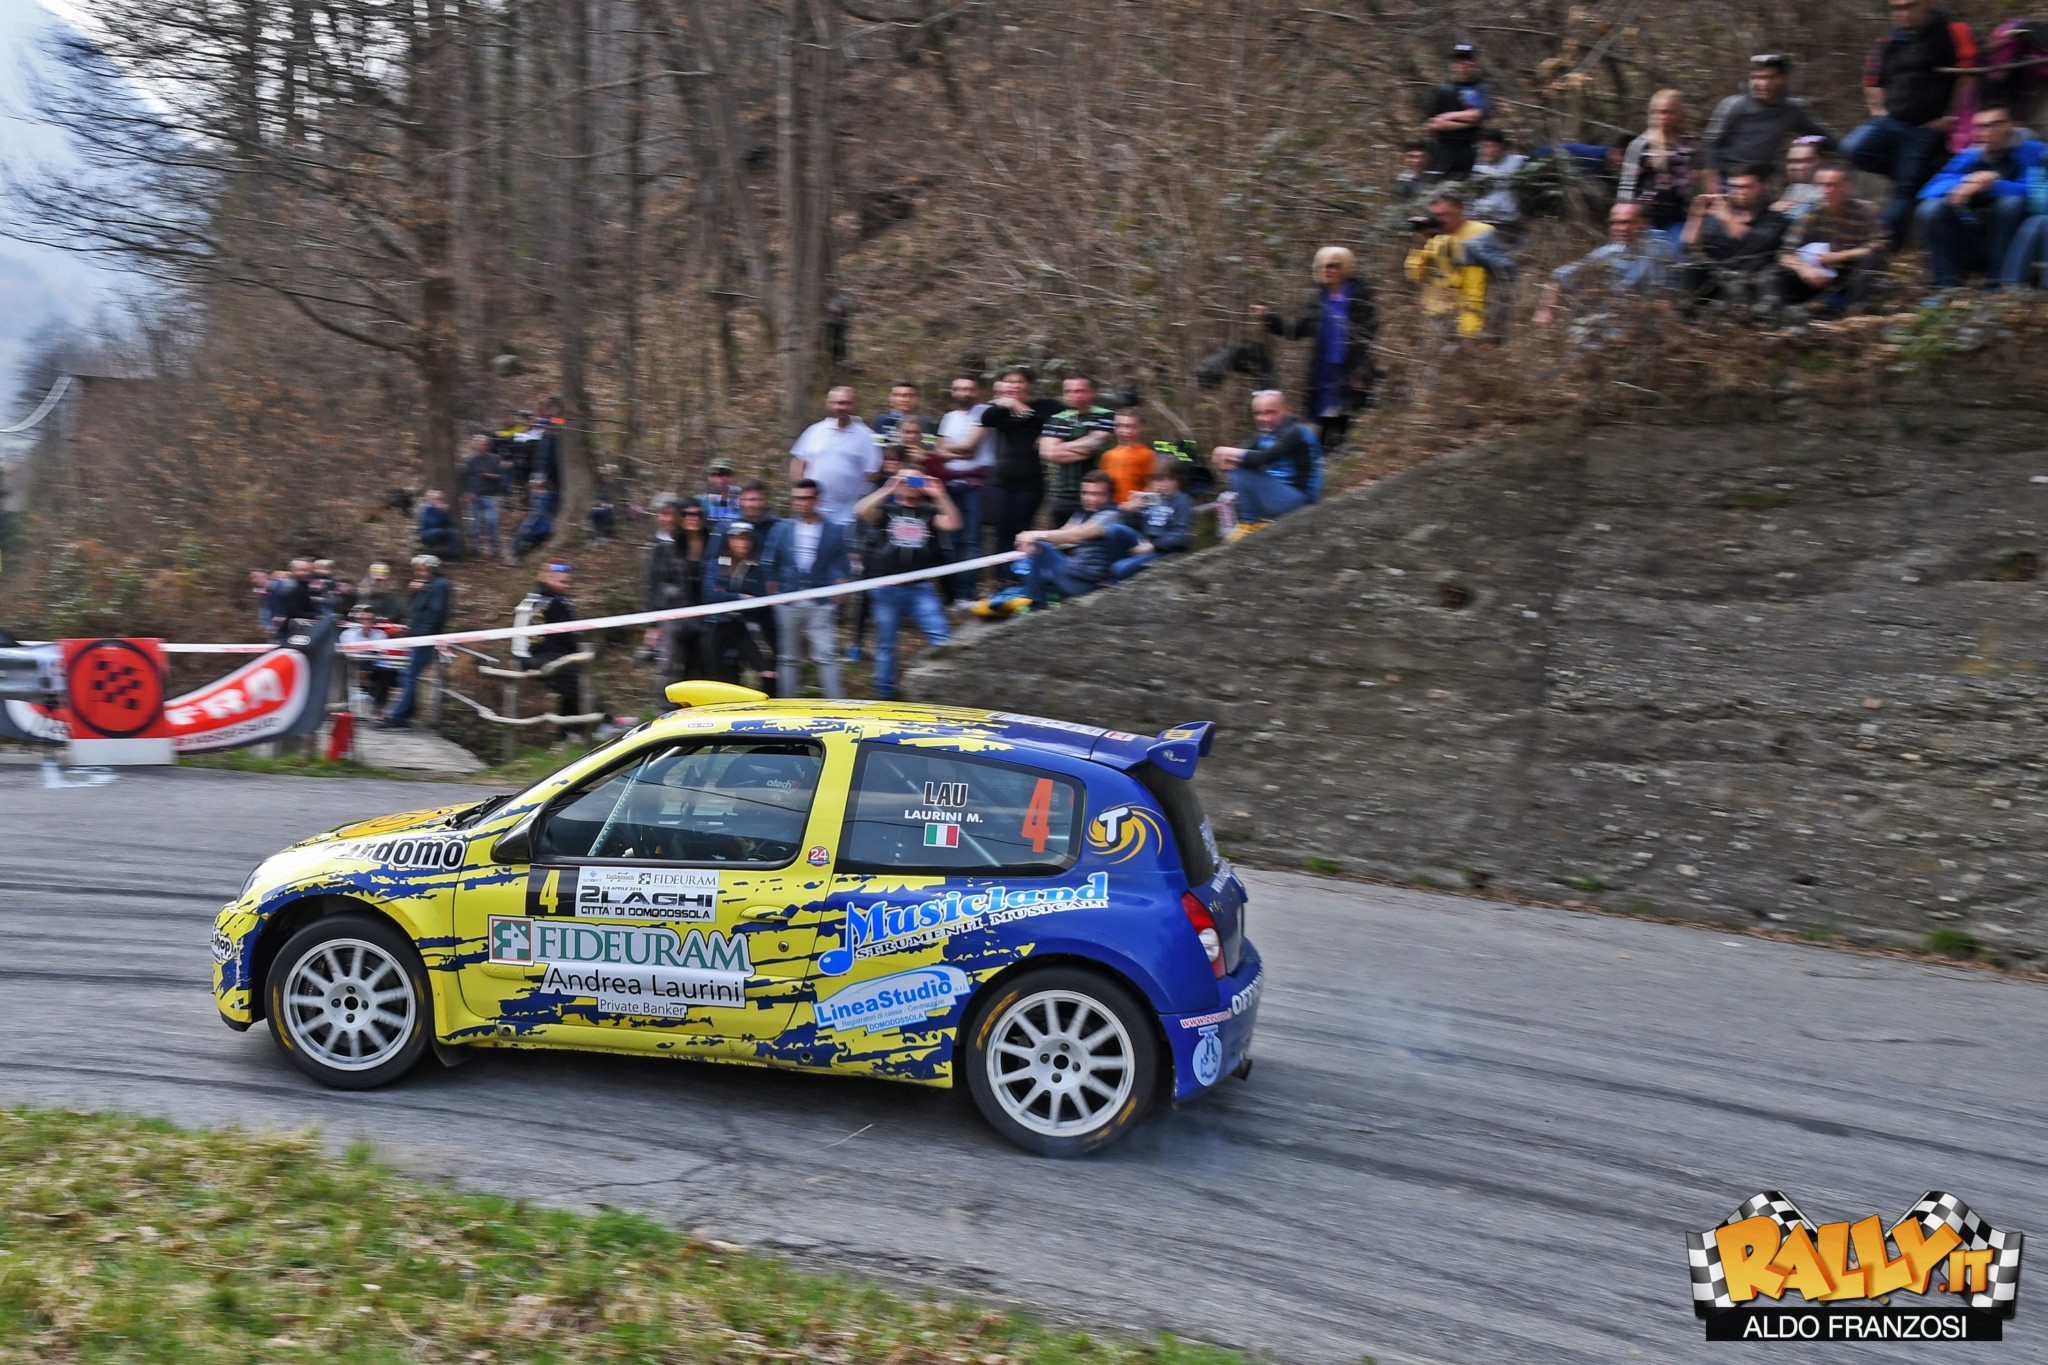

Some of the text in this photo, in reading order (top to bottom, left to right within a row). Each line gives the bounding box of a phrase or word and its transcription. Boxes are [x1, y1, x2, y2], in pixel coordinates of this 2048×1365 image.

[923, 781, 968, 808] LAU
[904, 809, 984, 823] LAURINI M.
[1022, 777, 1053, 853] 4
[810, 848, 829, 861] 24
[539, 870, 561, 914] 4
[653, 874, 716, 886] FIDEURAM
[615, 907, 625, 916] DI
[628, 907, 711, 919] DOMODOSSOLA
[846, 871, 1109, 948] Musicland
[856, 900, 1109, 960] STRUMENTI MUSICALI
[537, 925, 749, 972] FIDEURAM
[548, 968, 740, 1002] Andrea Laurini
[600, 1000, 685, 1016] Private Banker
[817, 979, 953, 1024] LineaStudio
[841, 1013, 877, 1027] Registratori
[877, 1012, 884, 1020] di
[884, 1009, 903, 1018] cassa
[869, 1013, 924, 1031] DOMODOSSOLA
